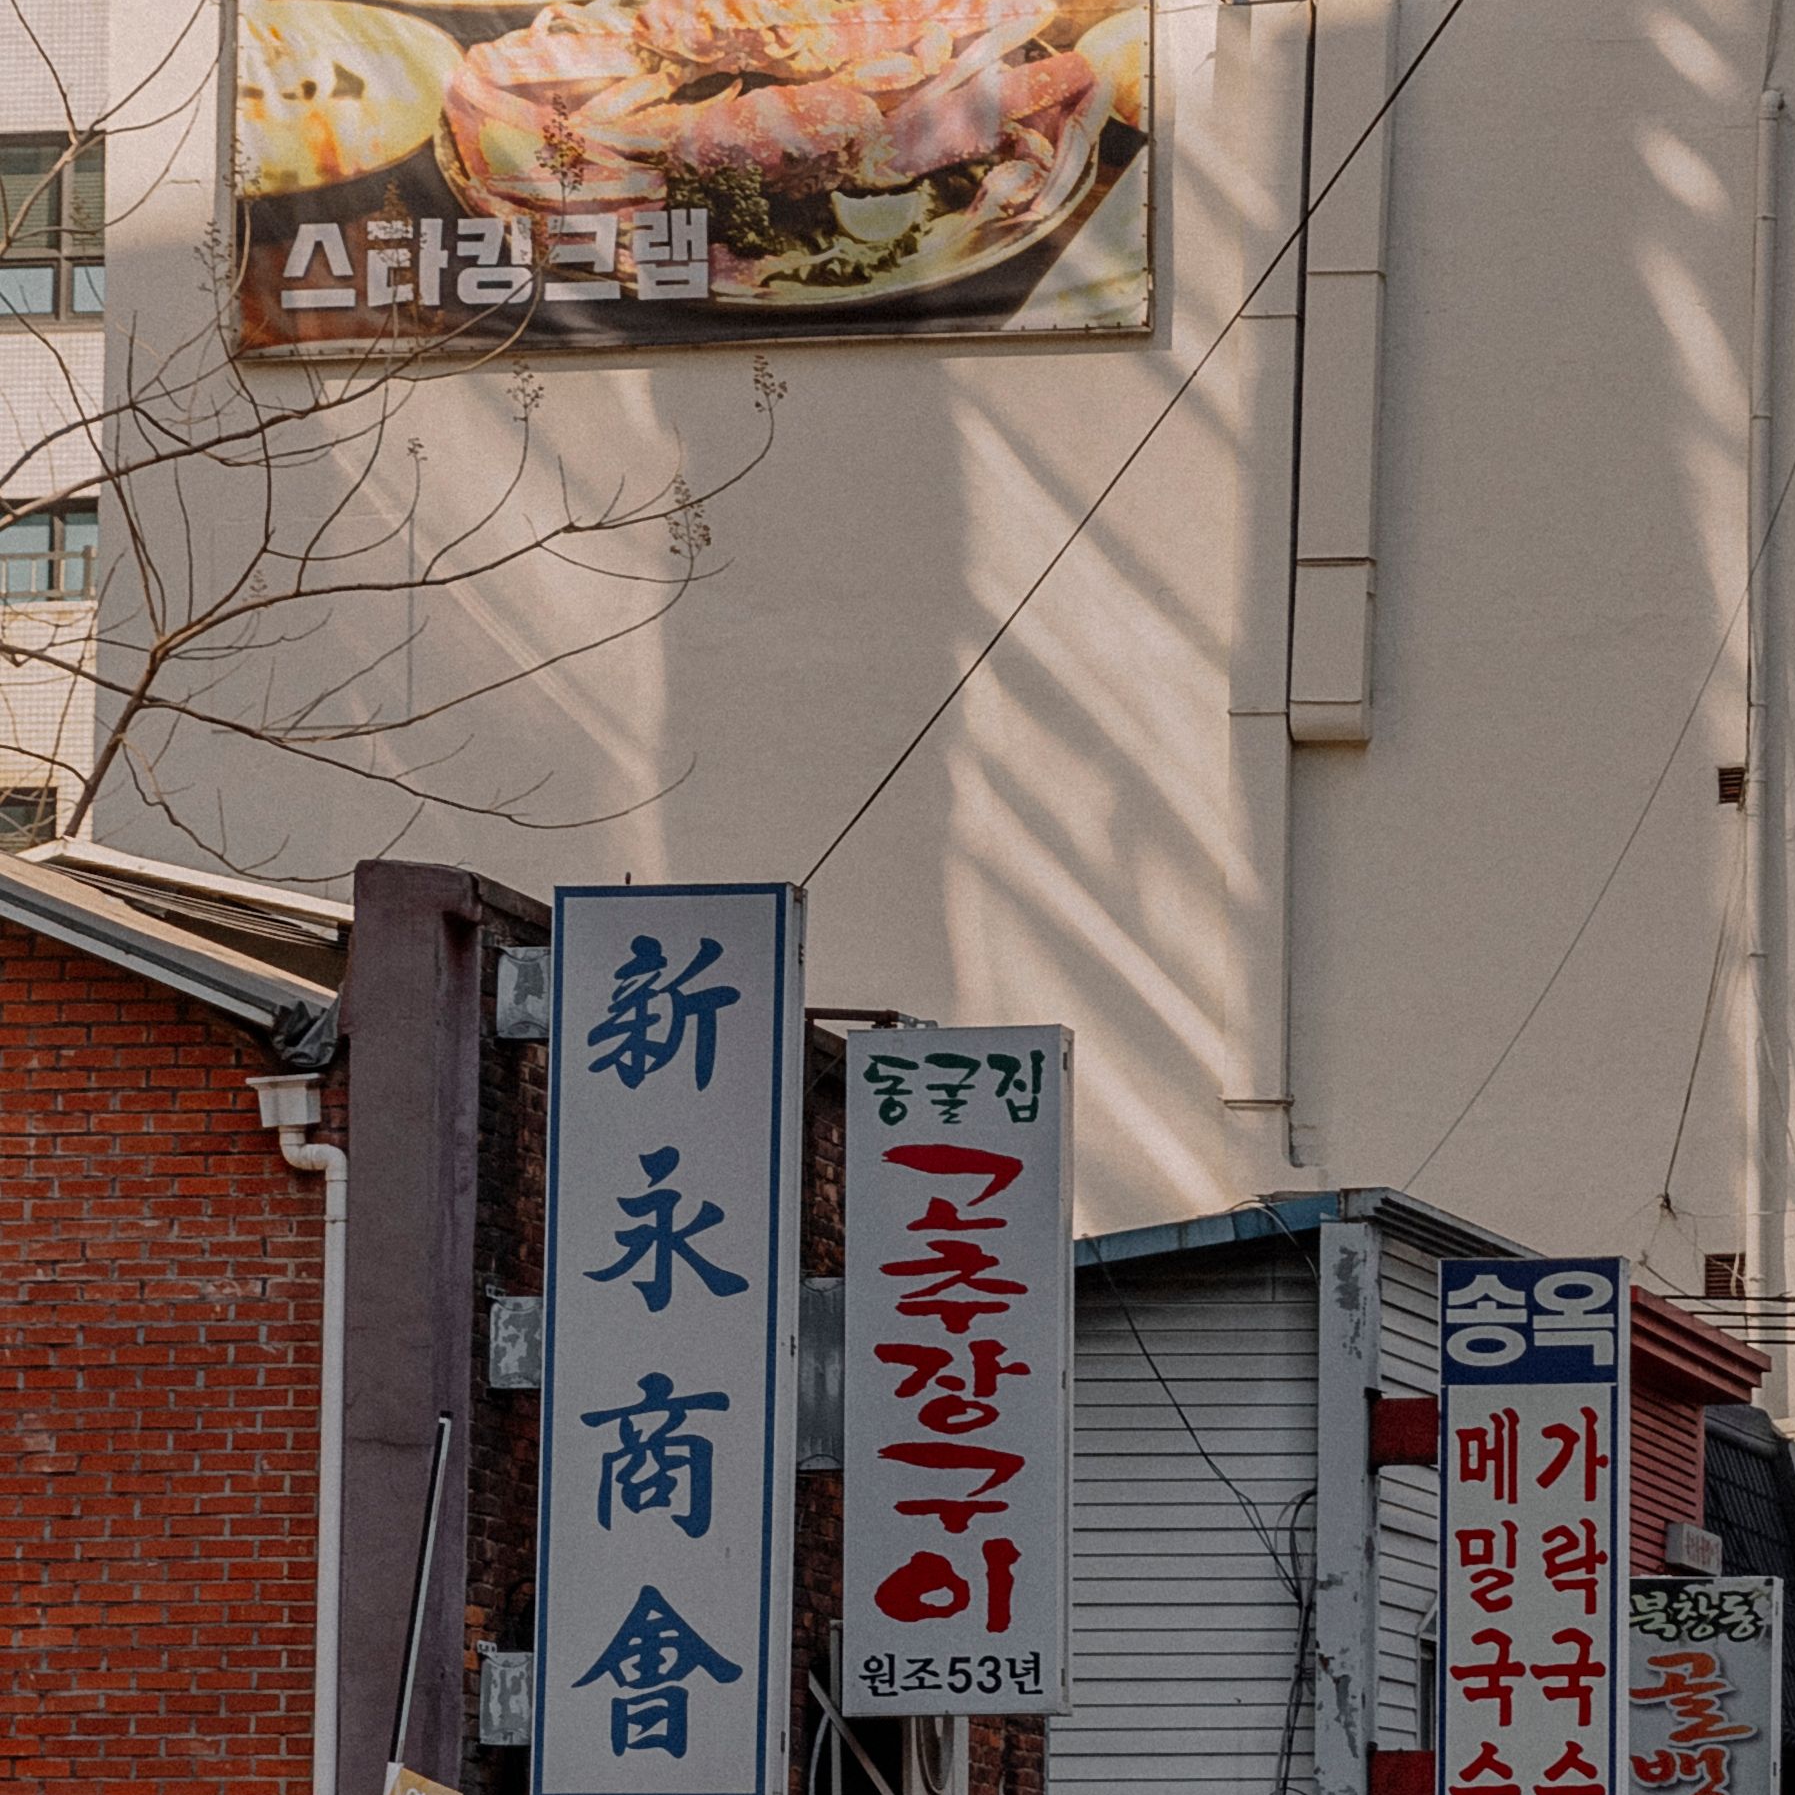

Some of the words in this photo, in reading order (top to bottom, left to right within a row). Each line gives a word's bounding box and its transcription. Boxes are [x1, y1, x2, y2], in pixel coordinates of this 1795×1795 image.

[280, 207, 710, 309] 스타킹크랩
[862, 1049, 1045, 1126] 동굴집
[571, 933, 751, 1760] 新永商會
[1445, 1270, 1615, 1367] 송옥
[873, 1143, 1032, 1634] 고추장구이
[1629, 1589, 1769, 1642] 북창동
[859, 1651, 1045, 1698] 원조53년
